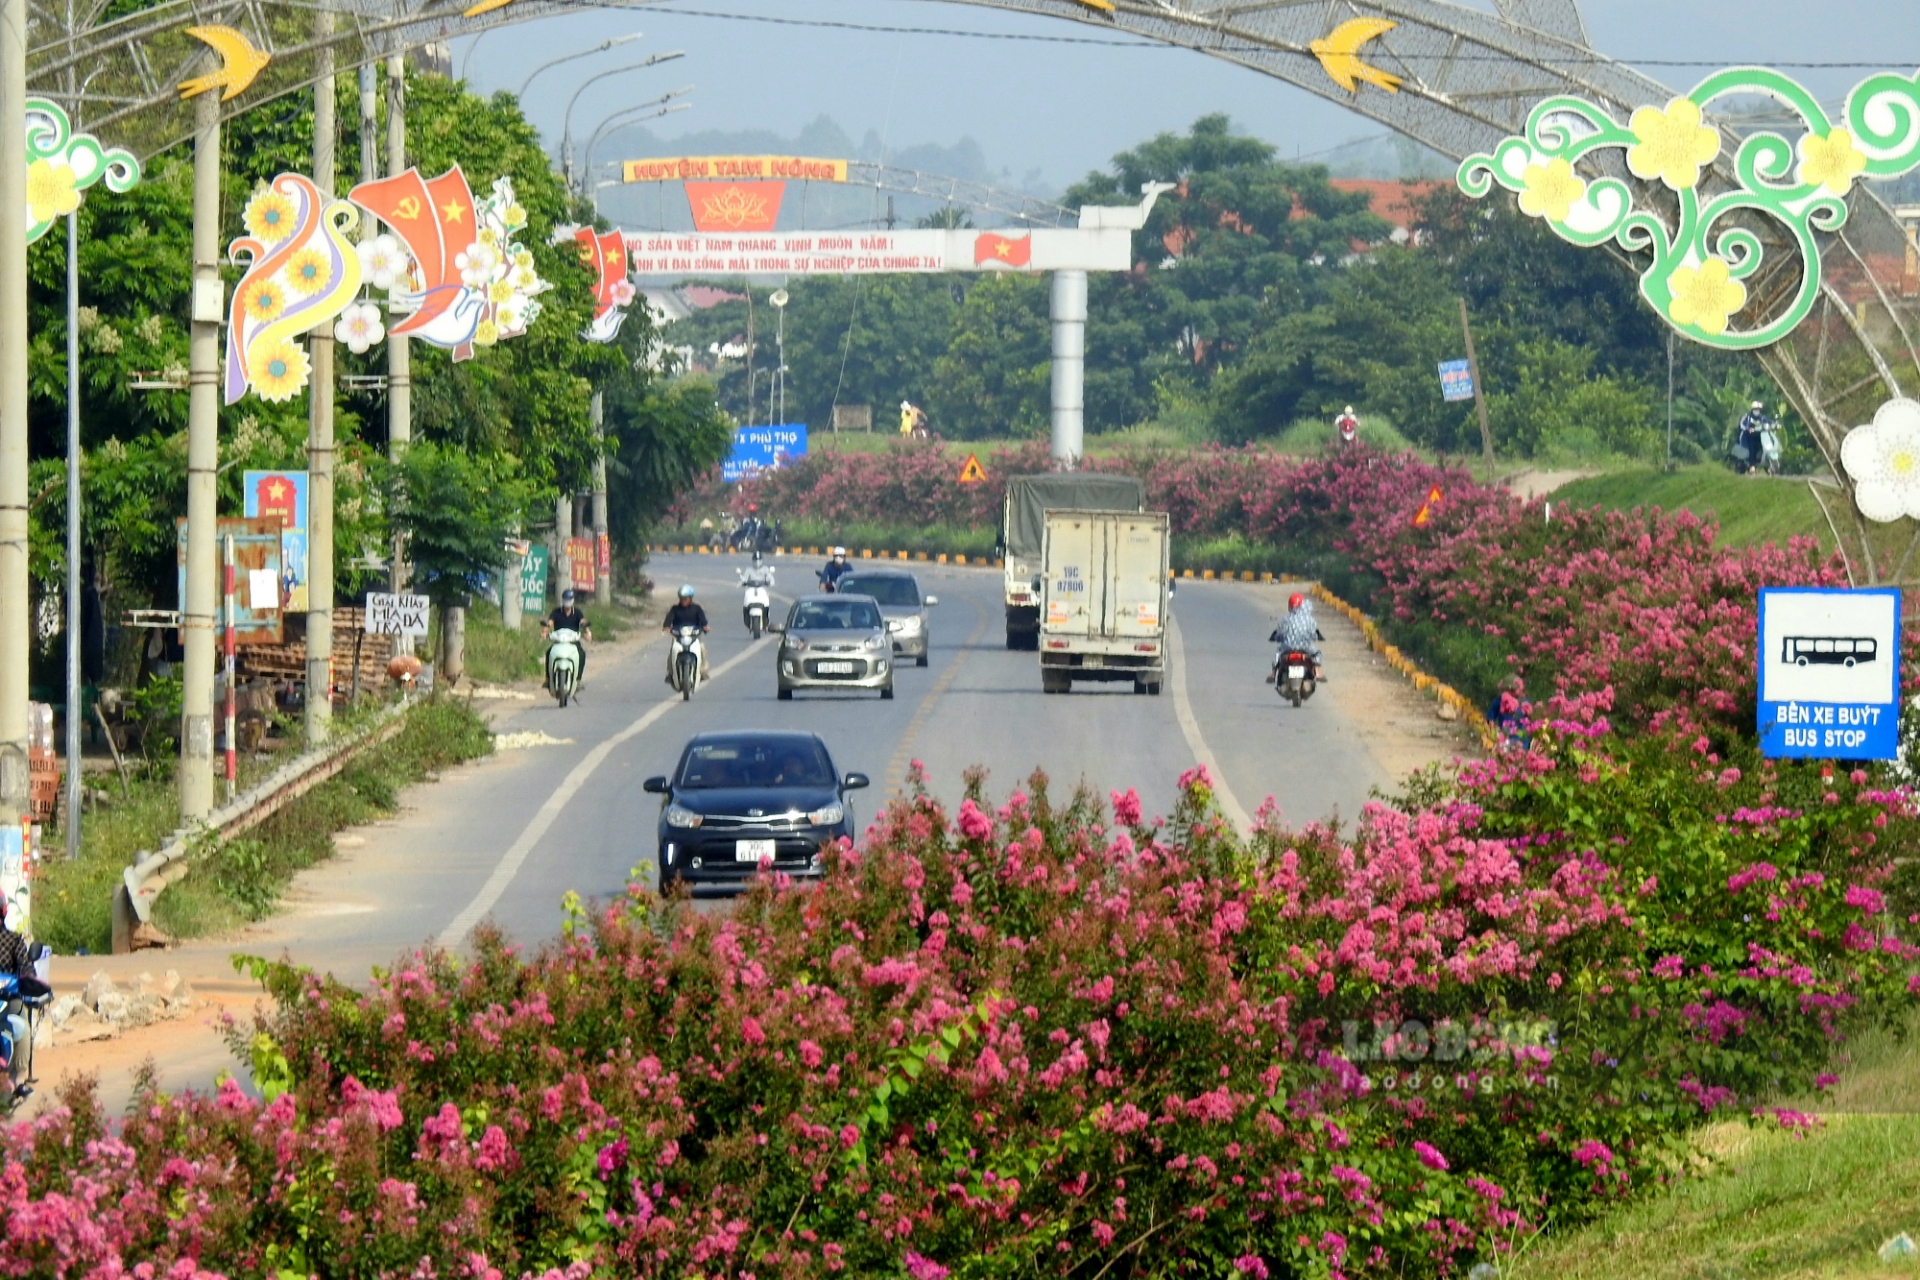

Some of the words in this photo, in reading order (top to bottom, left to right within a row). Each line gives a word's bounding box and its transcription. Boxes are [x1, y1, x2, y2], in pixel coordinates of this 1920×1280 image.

[714, 159, 763, 176] TAM
[771, 158, 835, 179] NÔNG
[626, 239, 642, 252] NG
[705, 239, 732, 251] NAM
[738, 239, 777, 251] QUANG
[784, 239, 812, 252] VINH
[634, 259, 653, 271] INH
[753, 258, 790, 270] TRONG
[750, 429, 772, 444] PHÚ
[774, 431, 798, 446] THỌ
[1813, 707, 1834, 724] XE
[1838, 705, 1880, 726] BUÝT
[1784, 729, 1818, 747] BUS
[1824, 729, 1866, 748] STOP
